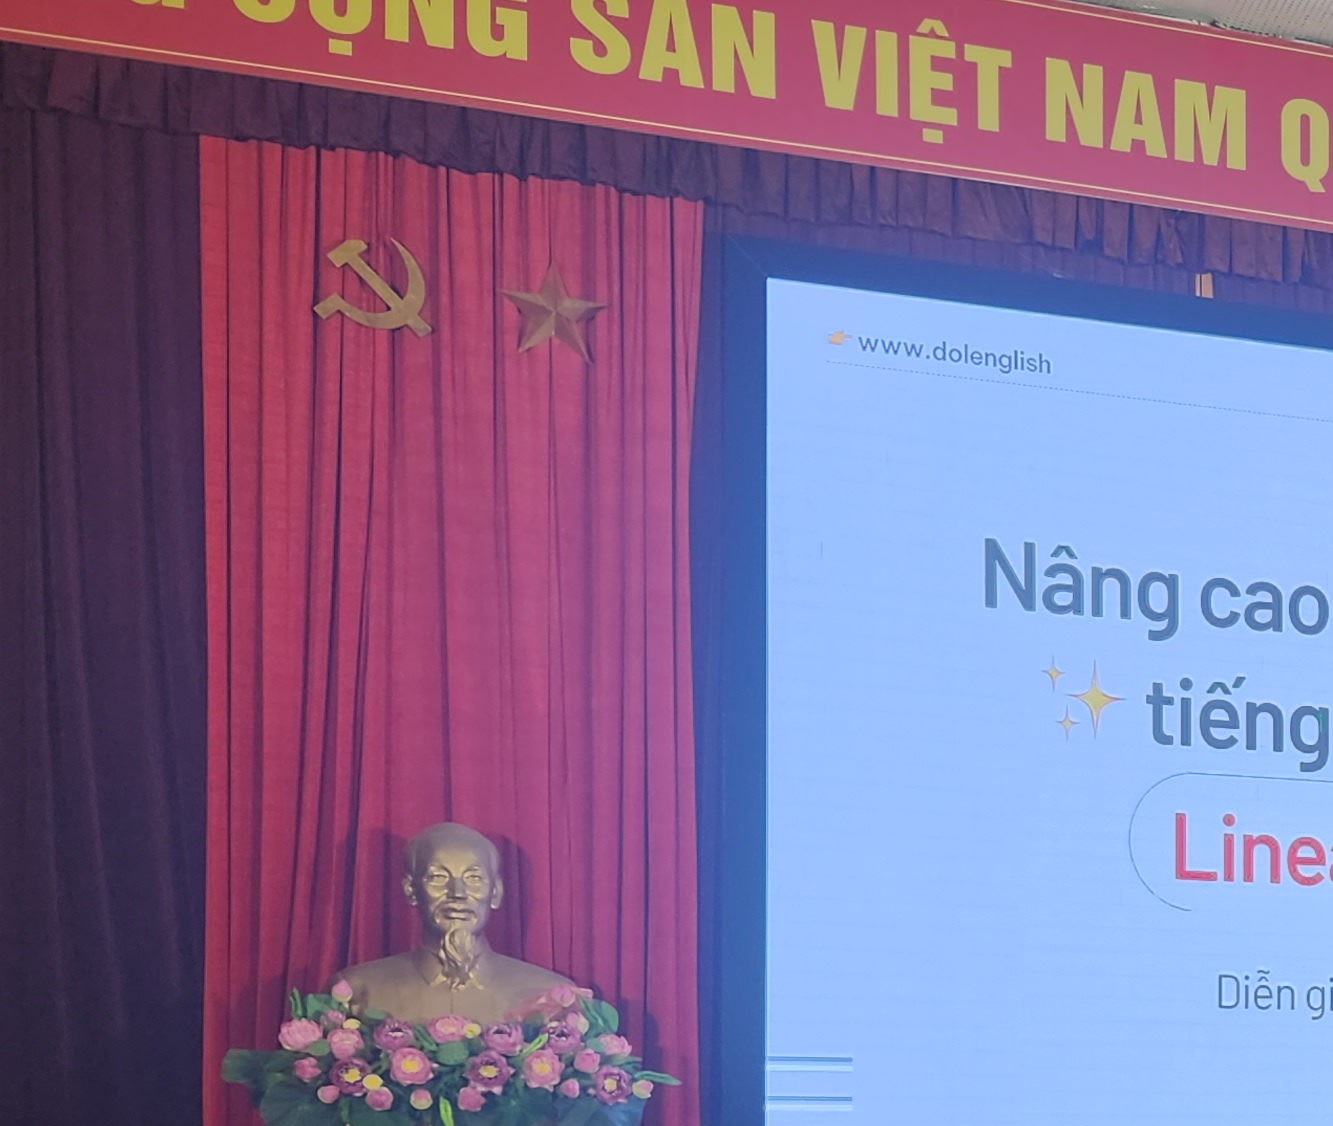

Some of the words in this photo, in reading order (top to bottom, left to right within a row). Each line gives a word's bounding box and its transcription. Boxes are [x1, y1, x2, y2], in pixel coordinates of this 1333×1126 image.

[812, 20, 1012, 143] VIỆT
[1046, 58, 1246, 170] NAM
[858, 336, 1052, 375] www.dolenglish
[984, 538, 1180, 642] Nâng
[1200, 577, 1329, 636] cao
[1145, 676, 1329, 773] tiếng
[1217, 969, 1296, 1011] Diễn
